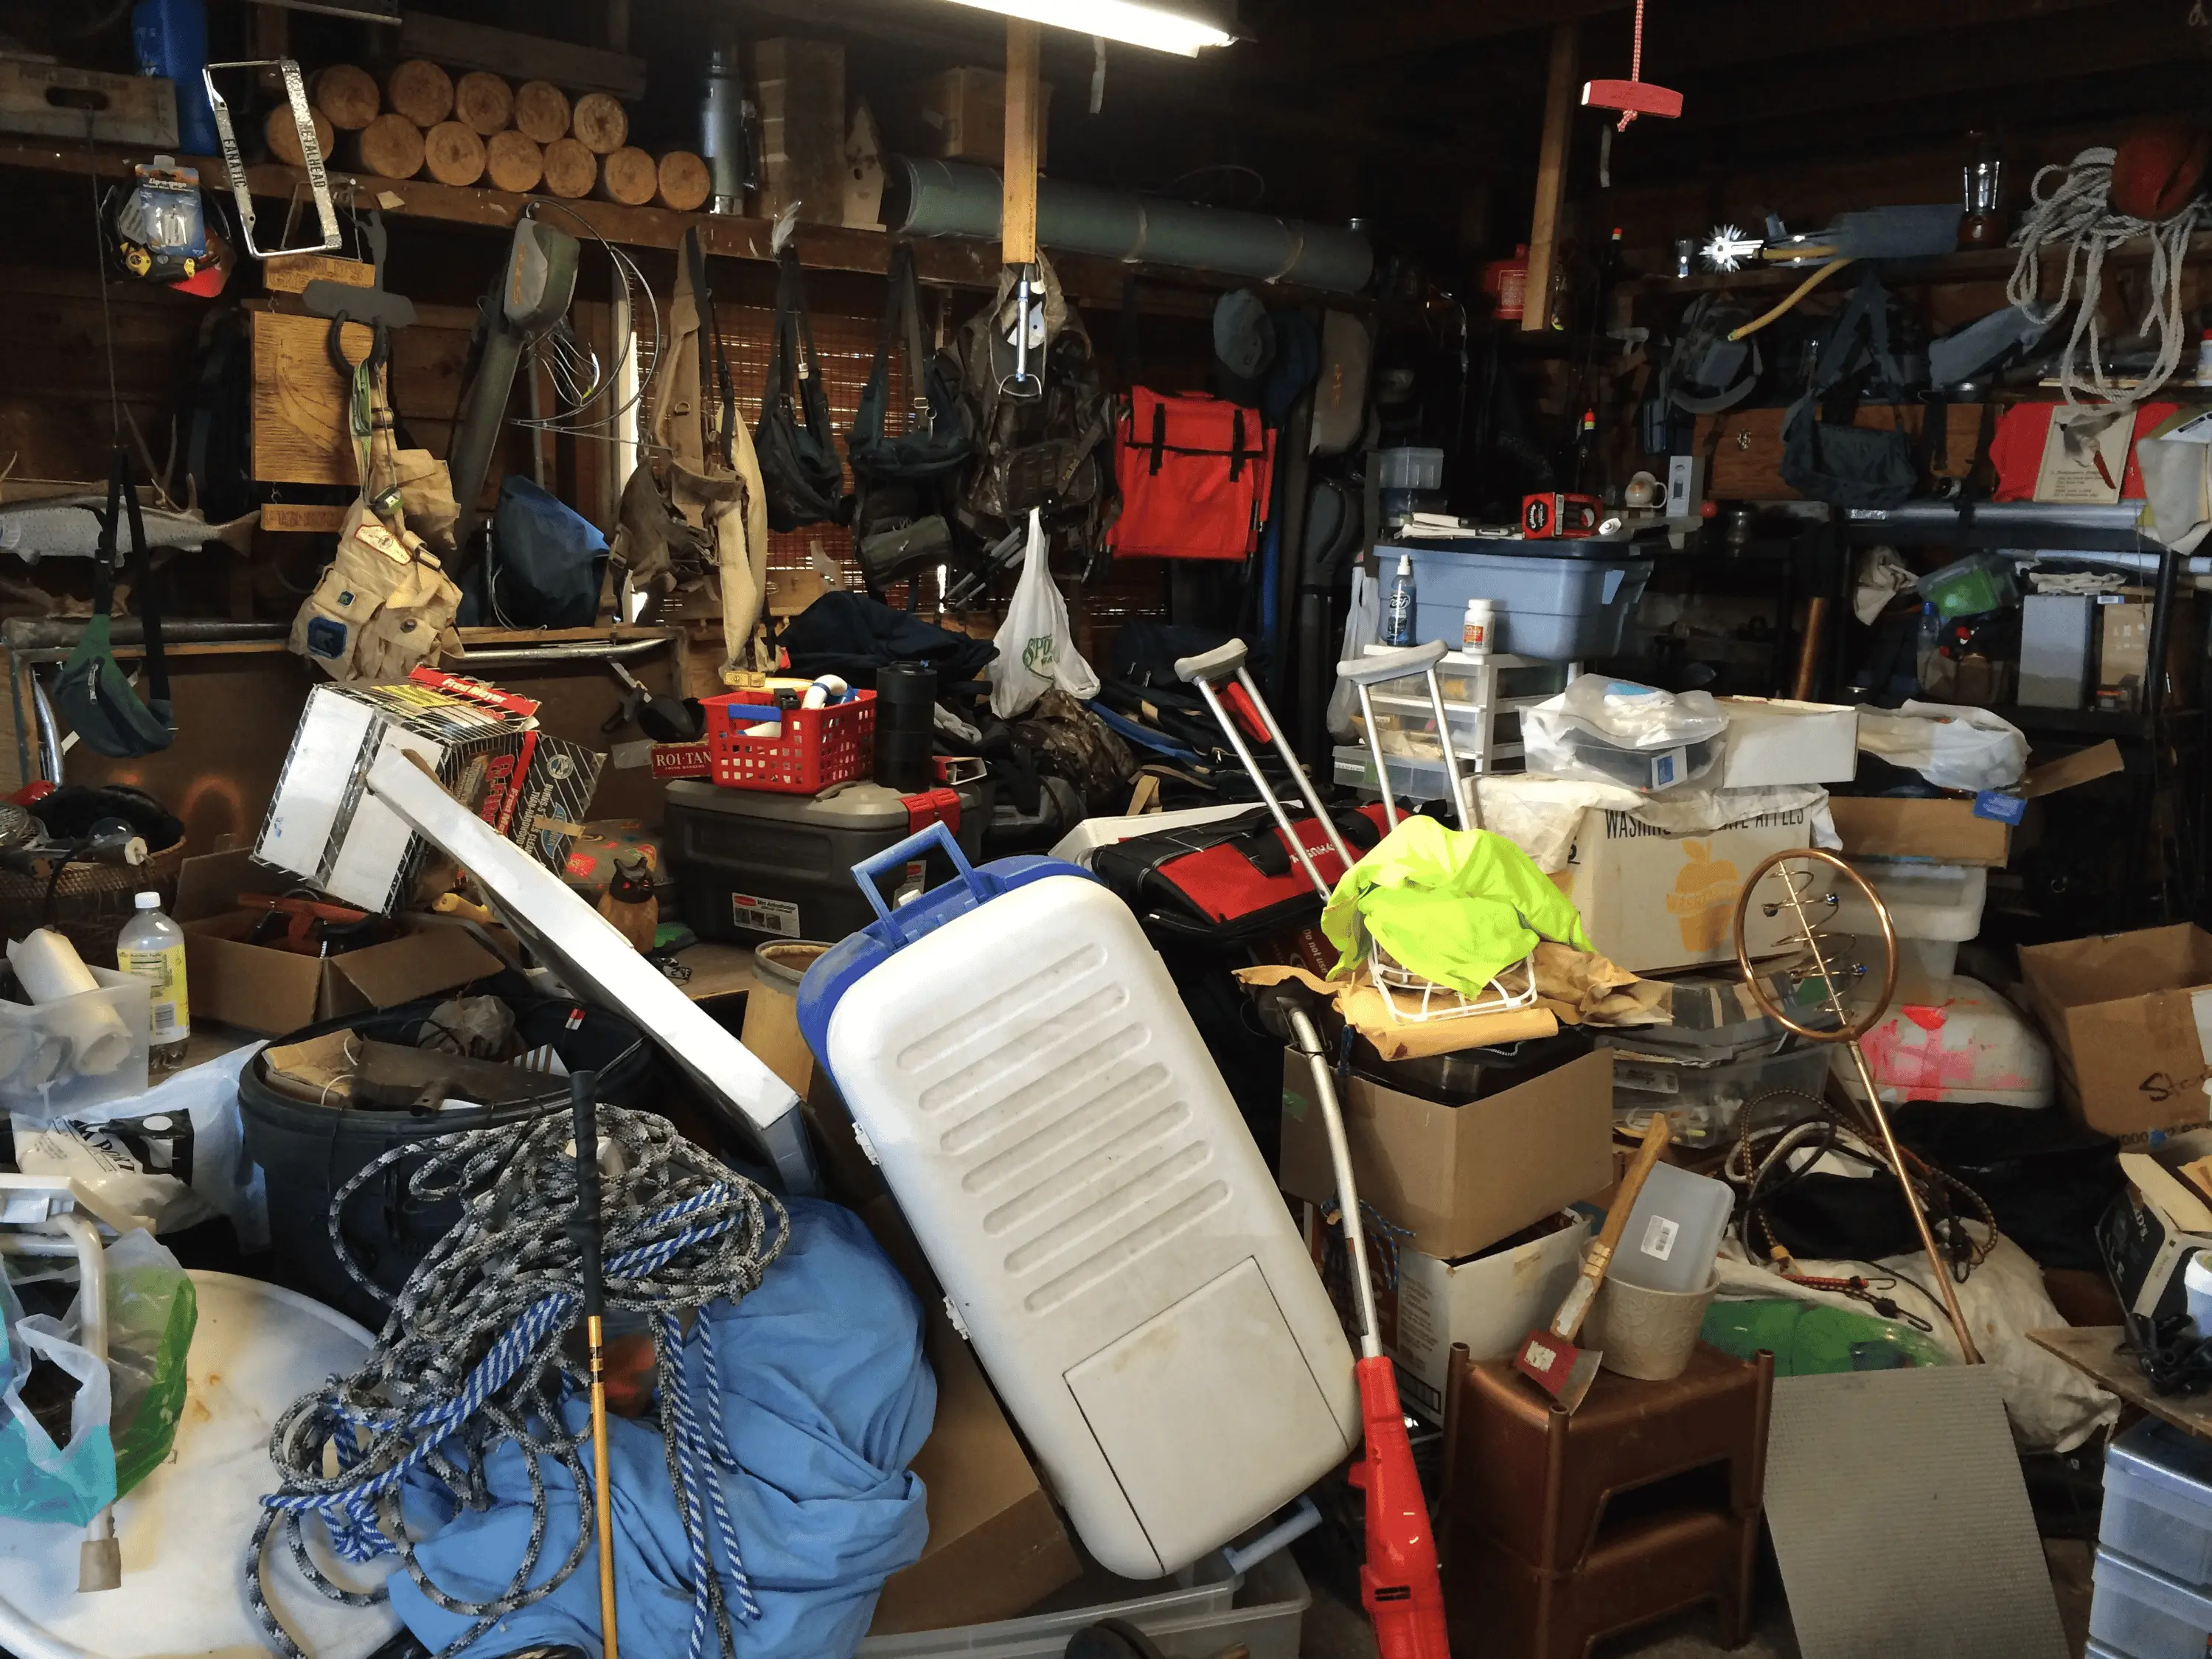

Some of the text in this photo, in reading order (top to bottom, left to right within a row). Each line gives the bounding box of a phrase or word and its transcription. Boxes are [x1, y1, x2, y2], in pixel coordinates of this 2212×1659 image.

[223, 138, 246, 188] FANATIC
[442, 678, 507, 703] Fred Meyer
[504, 787, 520, 816] Fred
[528, 790, 540, 808] THAN
[1303, 929, 1328, 974] Do not use
